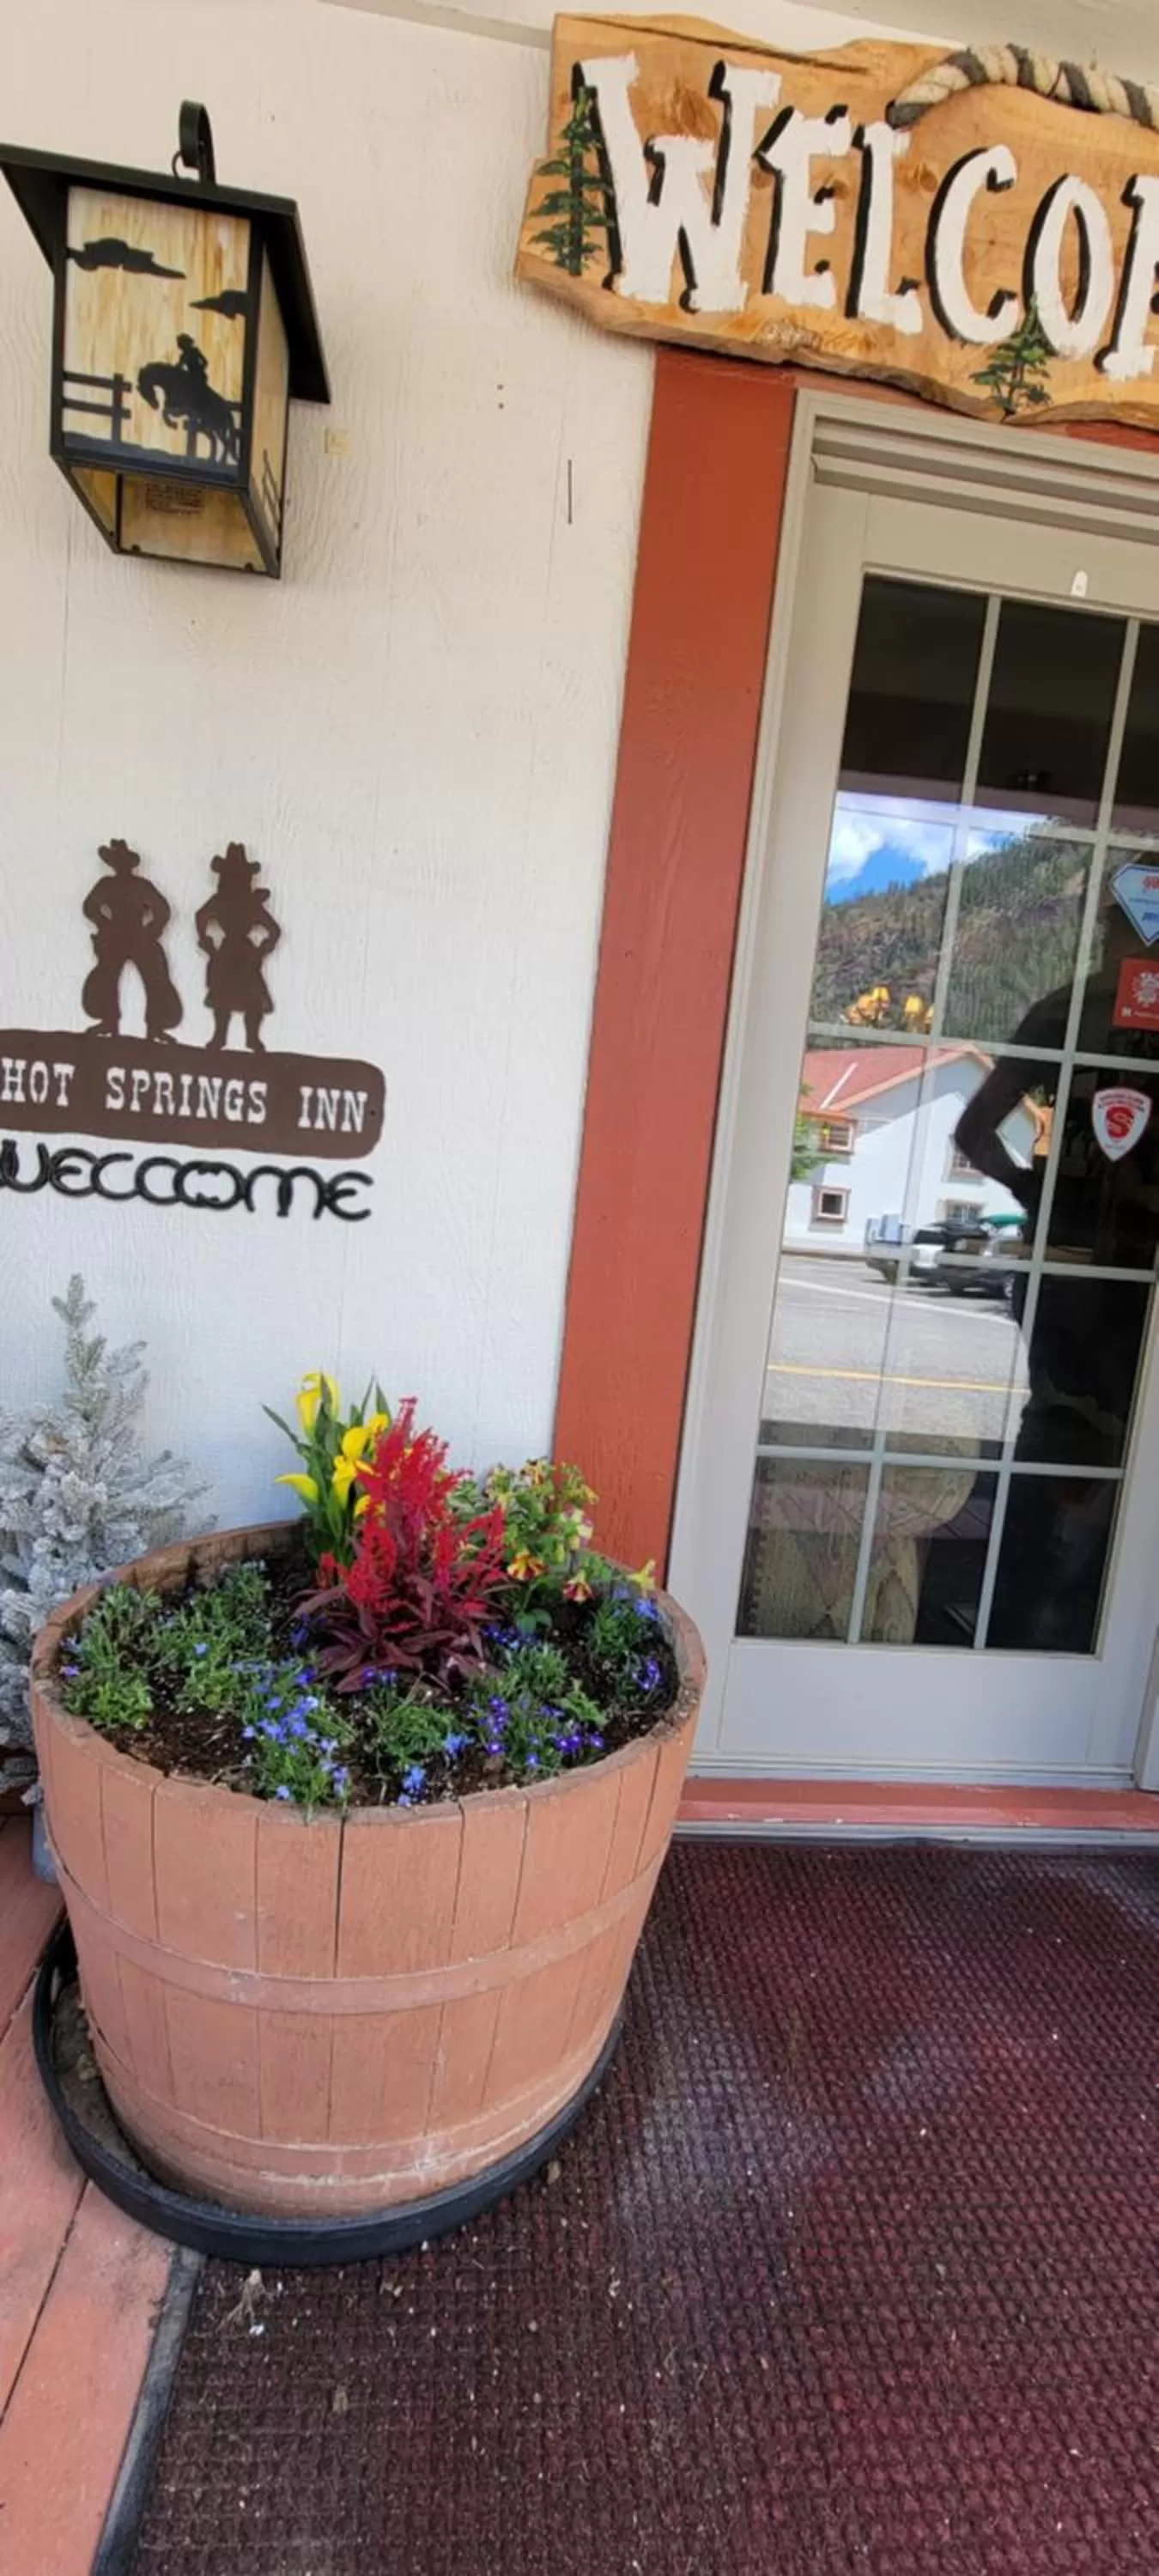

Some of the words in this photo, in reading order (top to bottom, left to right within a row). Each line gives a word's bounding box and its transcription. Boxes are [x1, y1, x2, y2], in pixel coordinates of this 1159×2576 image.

[1, 1058, 76, 1108] HOT
[106, 1067, 268, 1123] SPRINGS
[297, 1086, 368, 1133] INN
